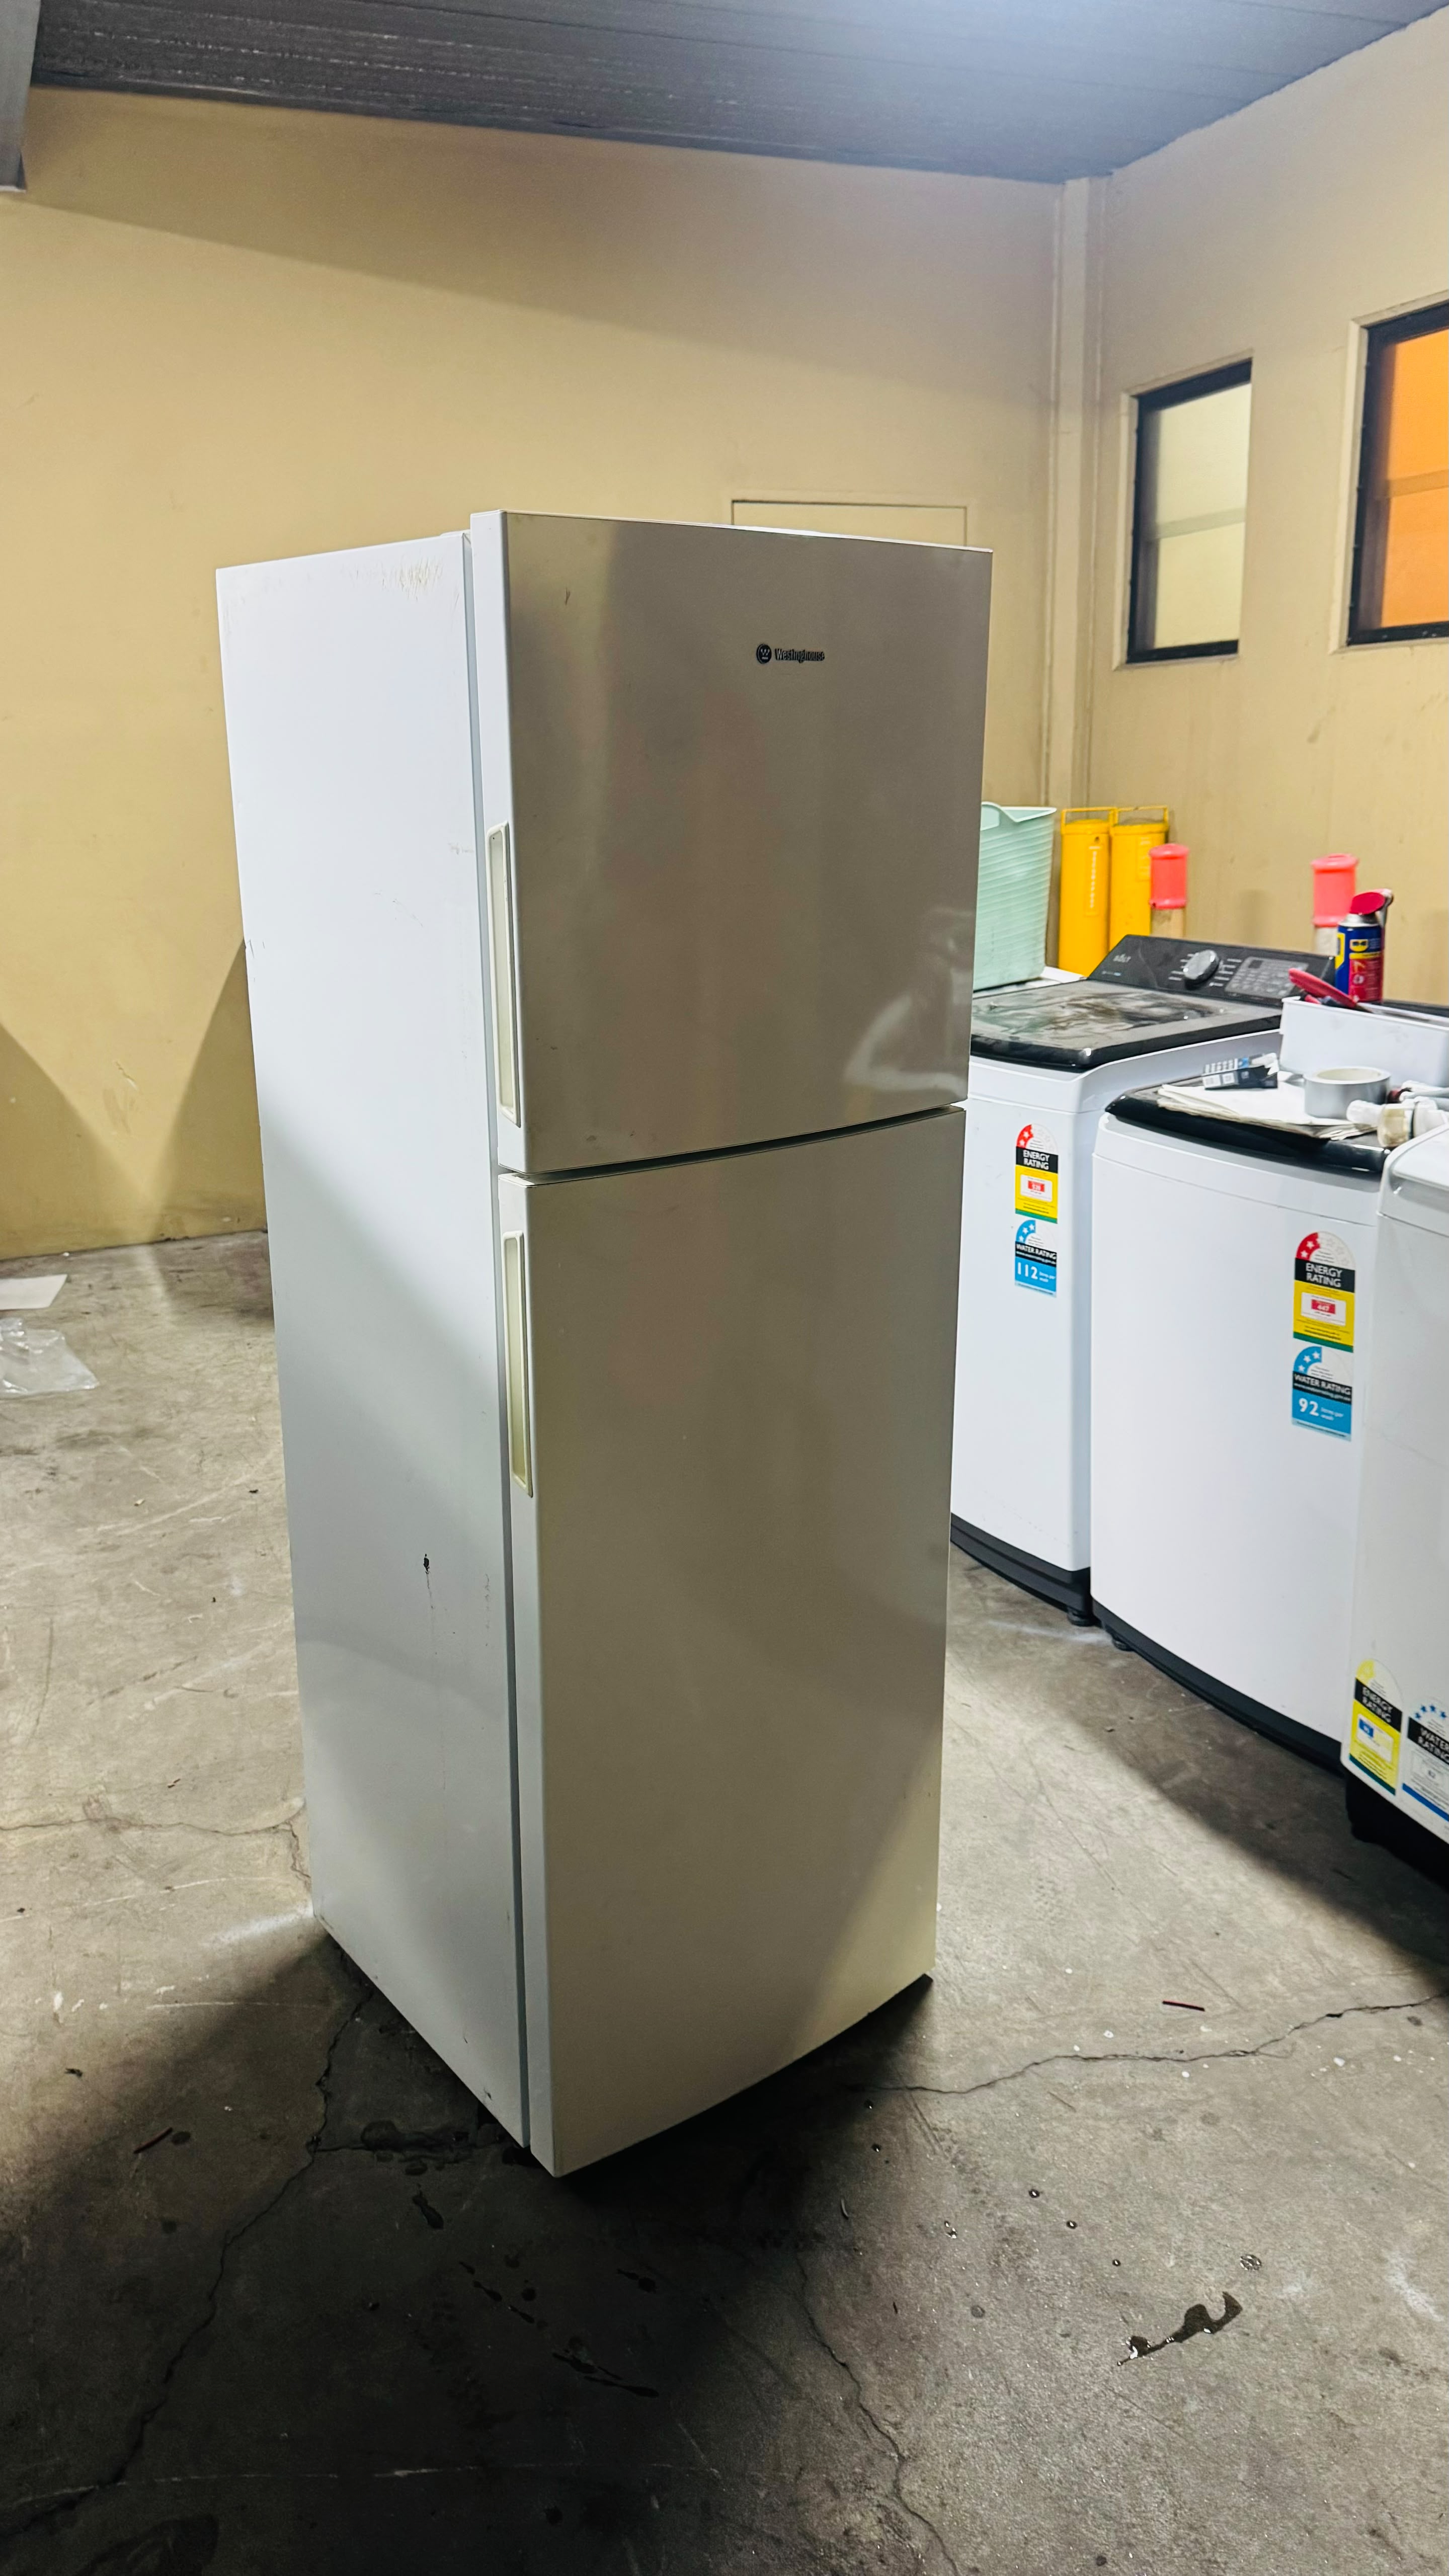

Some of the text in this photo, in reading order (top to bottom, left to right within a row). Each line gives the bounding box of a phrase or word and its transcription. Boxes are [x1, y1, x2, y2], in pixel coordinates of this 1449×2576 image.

[774, 648, 825, 663] Westinghouse
[1023, 1149, 1050, 1162] ENERGY
[1023, 1158, 1049, 1170] RATING
[1016, 1244, 1035, 1253] WATER
[1017, 1262, 1038, 1279] 112
[1305, 1262, 1343, 1278] ENERGY
[1306, 1272, 1341, 1287] RATING
[1295, 1374, 1320, 1387] WATER
[1321, 1381, 1351, 1395] RATING
[1299, 1398, 1319, 1416] 92
